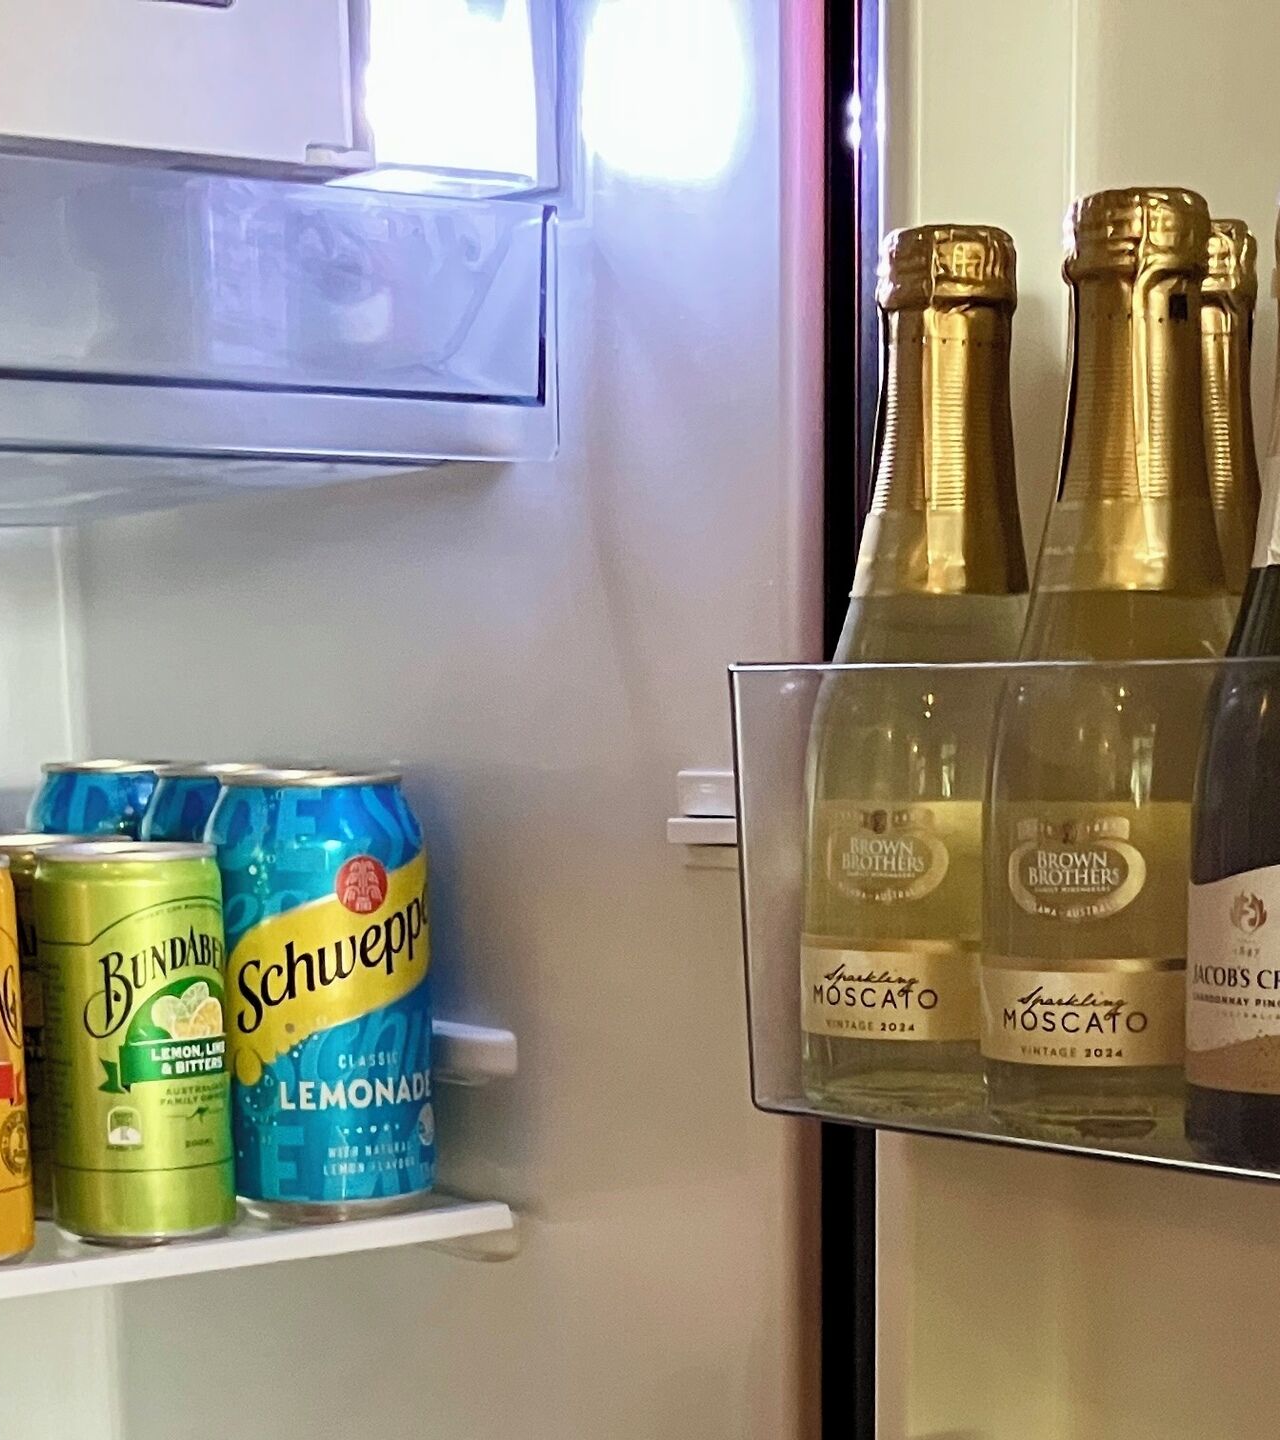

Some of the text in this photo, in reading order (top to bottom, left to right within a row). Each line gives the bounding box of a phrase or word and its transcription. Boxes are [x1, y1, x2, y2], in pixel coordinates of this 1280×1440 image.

[849, 836, 914, 857] BROWN
[841, 851, 925, 873] BROTHERS
[1037, 849, 1109, 870] BROWN
[1028, 866, 1121, 887] BROTHERS
[236, 892, 430, 1035] Schwepp
[824, 963, 919, 998] Sparkling
[1192, 962, 1251, 989] JACOB'S
[813, 983, 939, 1010] MOSCATO
[1017, 985, 1129, 1021] Sparkling
[825, 1019, 916, 1033] VINTAGE 2024
[1003, 1007, 1148, 1034] MOSCATO
[338, 1050, 399, 1070] CLASSIC
[1021, 1045, 1124, 1058] VINTAGE 2024
[161, 1062, 172, 1075] &
